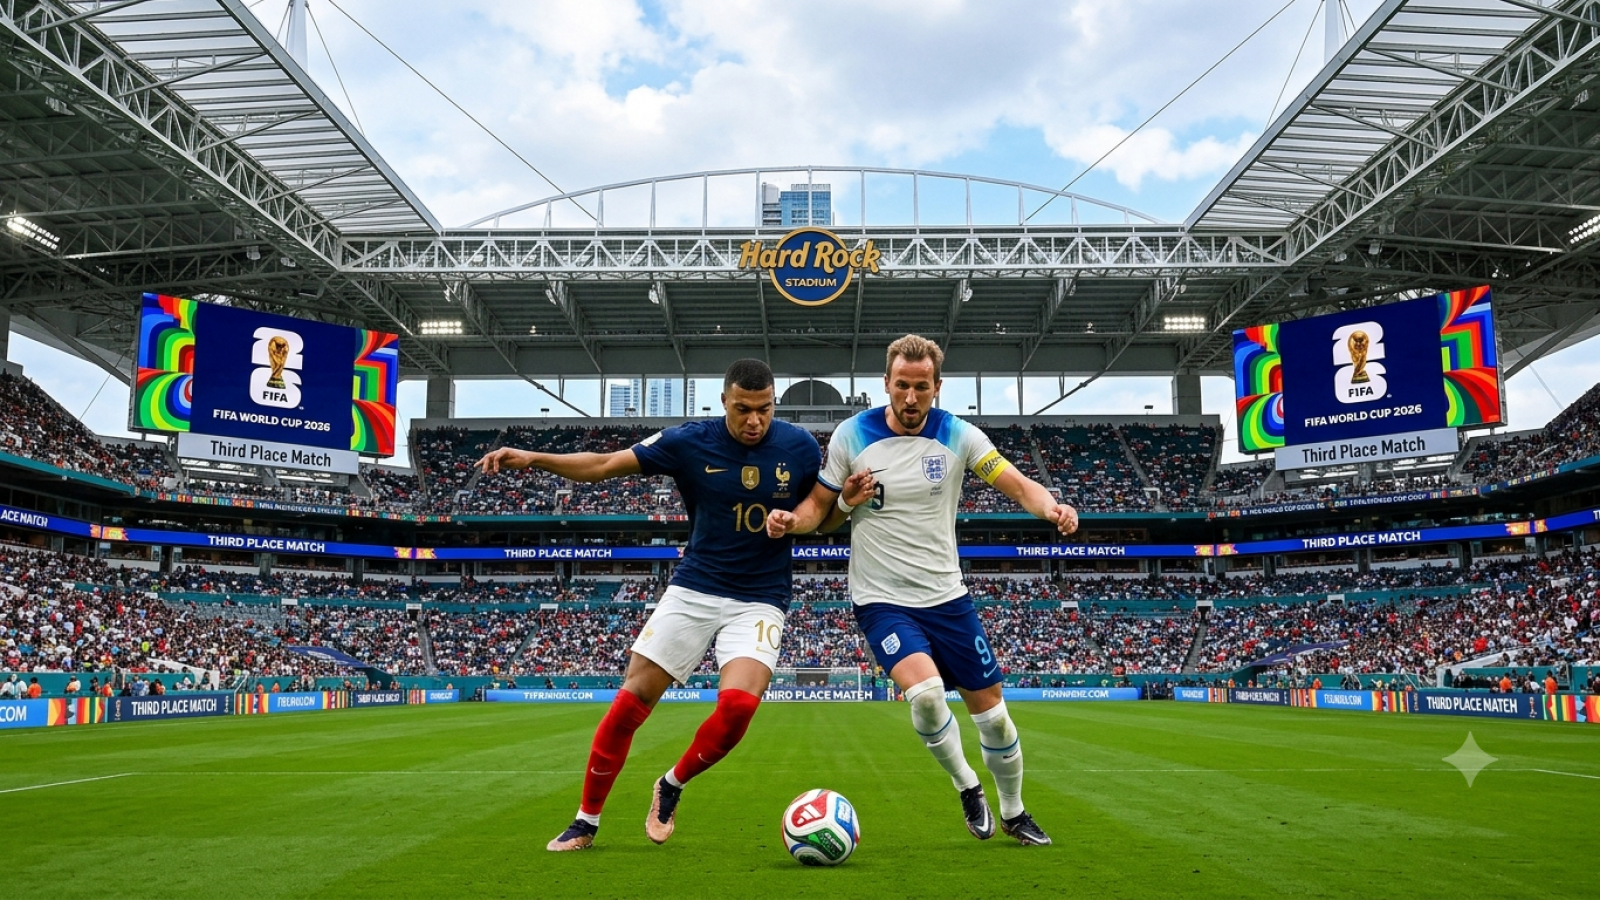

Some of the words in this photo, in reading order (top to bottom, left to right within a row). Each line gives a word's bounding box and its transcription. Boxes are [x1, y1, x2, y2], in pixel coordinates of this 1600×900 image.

[738, 240, 811, 269] Hard
[813, 239, 881, 274] Rock
[785, 278, 837, 287] STADIUM
[262, 390, 288, 403] FIFA
[1348, 386, 1374, 398] FIFA
[213, 408, 238, 421] FIFA
[240, 412, 279, 426] WORLD
[281, 416, 302, 428] CUP
[1304, 416, 1328, 428] FIFA
[1328, 411, 1368, 425] WORLD
[1369, 408, 1392, 419] CUP
[1393, 404, 1422, 417] 2026
[210, 440, 246, 458] Third
[250, 445, 288, 463] Place
[291, 450, 331, 467] Match
[1302, 446, 1337, 463] Third
[1340, 441, 1377, 459] Place
[1381, 436, 1426, 454] Match
[732, 502, 768, 533] 10
[208, 535, 244, 547] THIRD
[246, 538, 284, 550] PLACE
[286, 540, 325, 552] MATCH
[1302, 537, 1335, 549] THIRD
[1338, 534, 1375, 546] PLACE
[1378, 531, 1420, 543] MATCH
[504, 549, 535, 558] THIRD
[538, 549, 572, 558] PLACE
[575, 549, 612, 558] MATCH
[1051, 547, 1085, 556] PLACE
[1088, 547, 1125, 556] MATCH
[754, 619, 782, 650] 10
[975, 635, 992, 665] 9
[795, 690, 831, 700] PLACE
[131, 701, 158, 716] THIRD
[161, 699, 189, 715] PLACE
[1426, 696, 1453, 710] THIRD
[1453, 697, 1482, 712] PLACE
